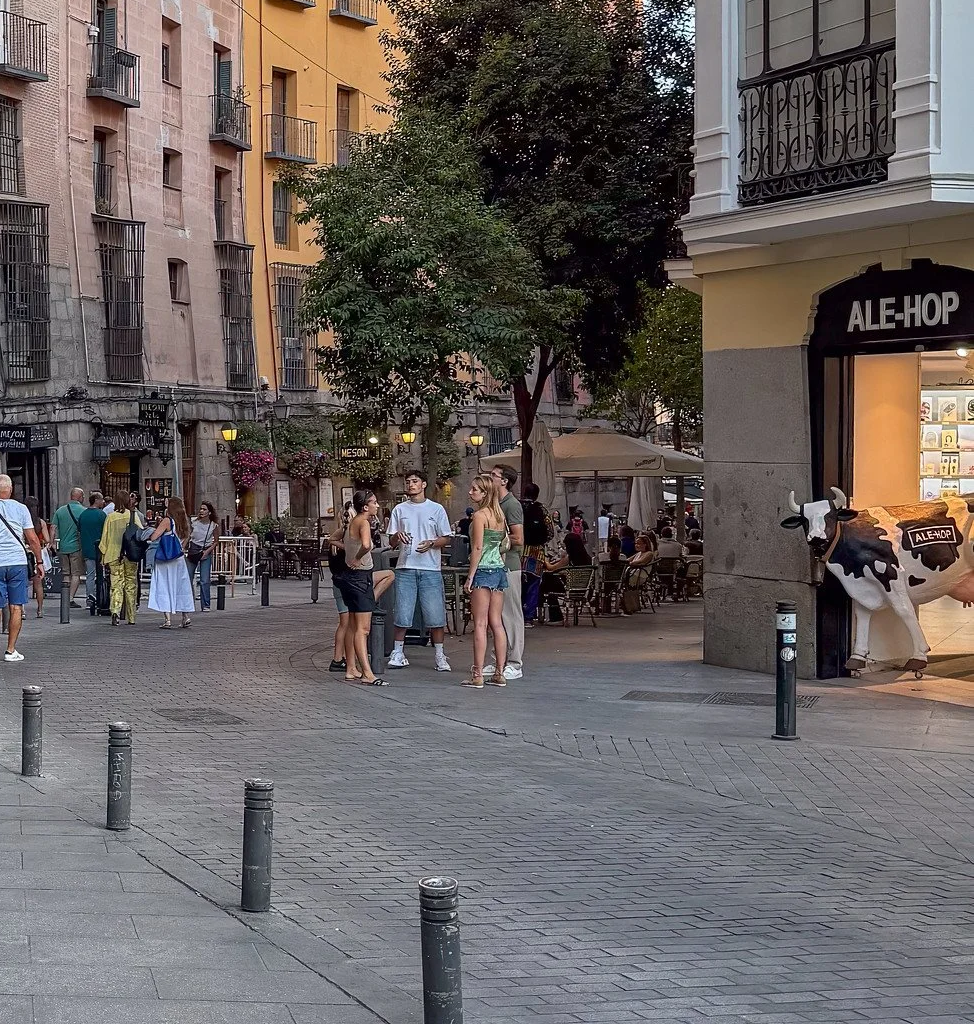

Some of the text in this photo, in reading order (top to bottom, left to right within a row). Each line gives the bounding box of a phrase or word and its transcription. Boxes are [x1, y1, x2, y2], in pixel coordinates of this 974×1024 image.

[847, 291, 960, 332] ALE-HOP
[341, 448, 367, 457] MESON
[916, 530, 951, 543] ALE-HOP
